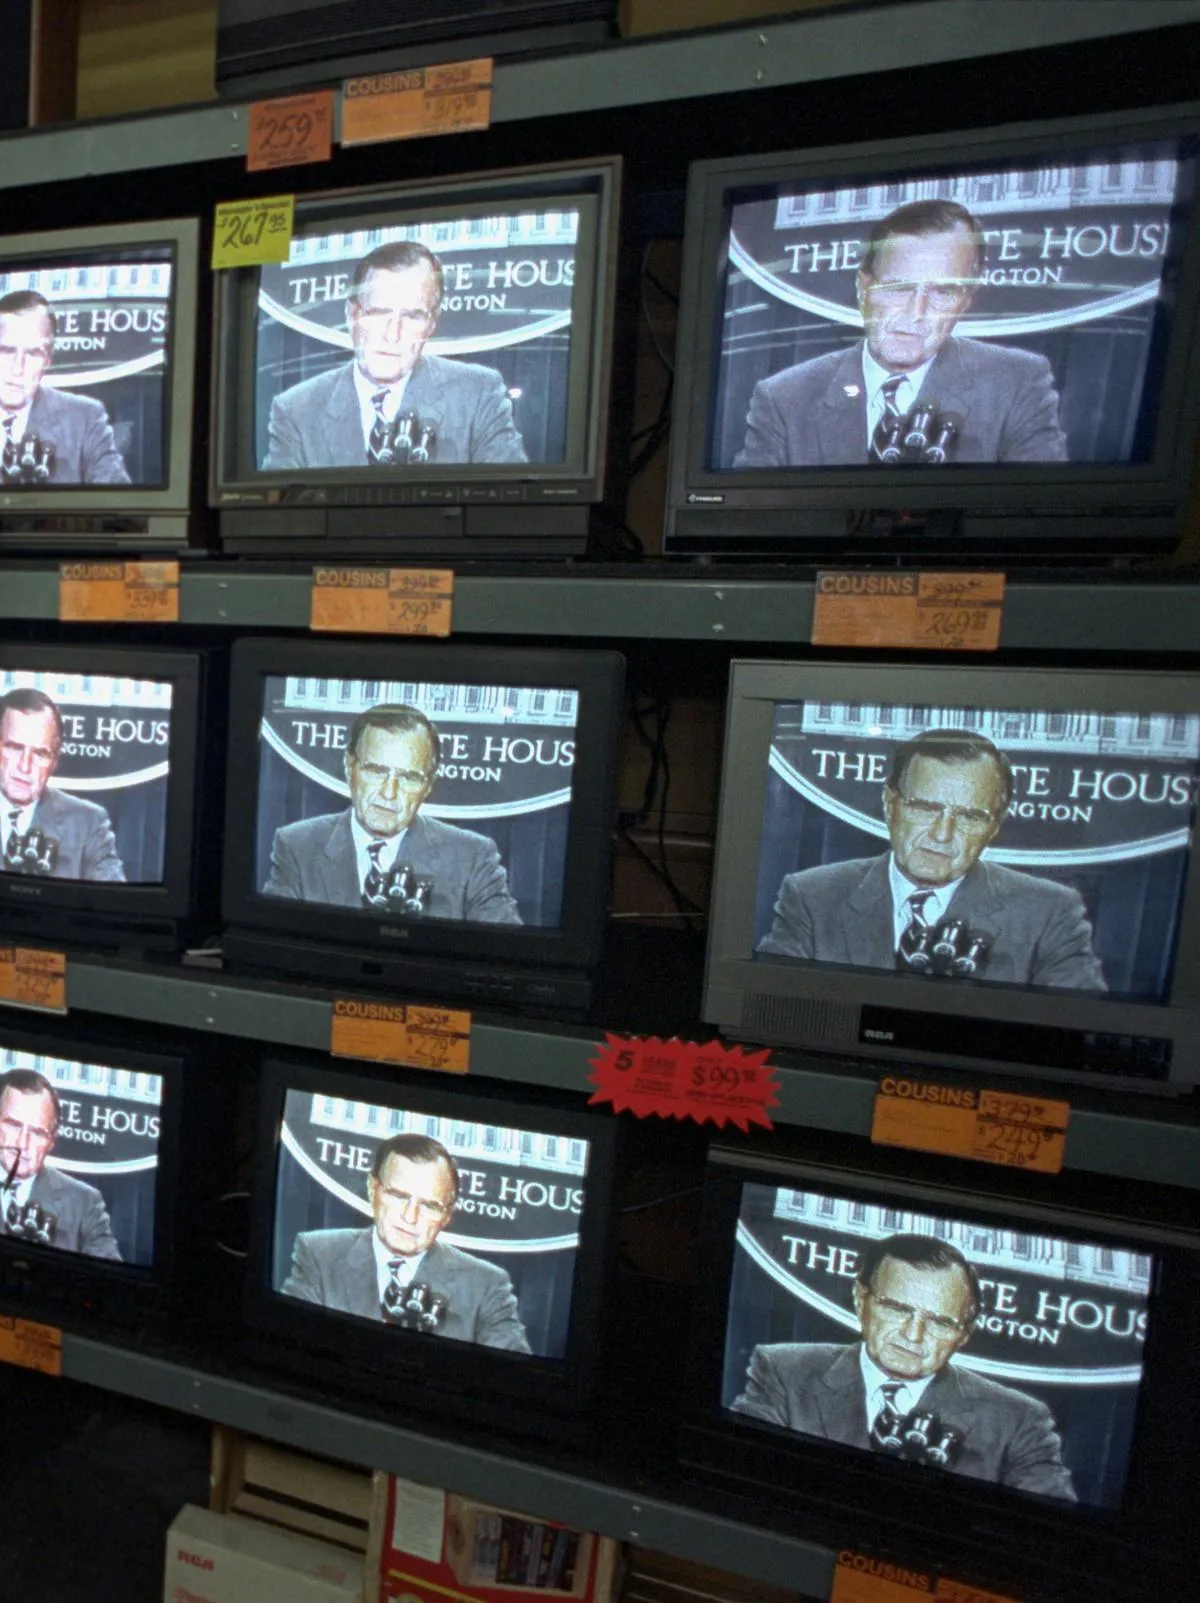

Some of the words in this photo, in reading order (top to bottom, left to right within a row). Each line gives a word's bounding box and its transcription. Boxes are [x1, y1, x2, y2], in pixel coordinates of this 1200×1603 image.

[346, 72, 423, 97] COUSINS
[785, 239, 862, 274] THE
[1040, 222, 1171, 260] HOUS
[288, 273, 349, 305] THE
[487, 259, 575, 289] HOUS
[89, 309, 166, 332] HOUS
[62, 562, 122, 580] COUSINS
[316, 569, 387, 587] COUSINS
[820, 575, 914, 594] COUSINS
[95, 716, 170, 745] HOUS
[291, 720, 348, 749] THE
[482, 735, 576, 767] HOUS
[812, 748, 887, 785] THE
[1070, 770, 1190, 806] HOUS
[1004, 802, 1094, 823] NGTON
[335, 1000, 404, 1022] COUSINS
[614, 1049, 635, 1071] 5
[881, 1076, 976, 1107] COUSINS
[92, 1105, 161, 1138] HOUS
[316, 1138, 373, 1171] THE
[500, 1177, 584, 1214] HOUS
[782, 1235, 860, 1279] THE
[974, 1315, 1061, 1346] NGTON
[839, 1550, 930, 1591] COUSINS
